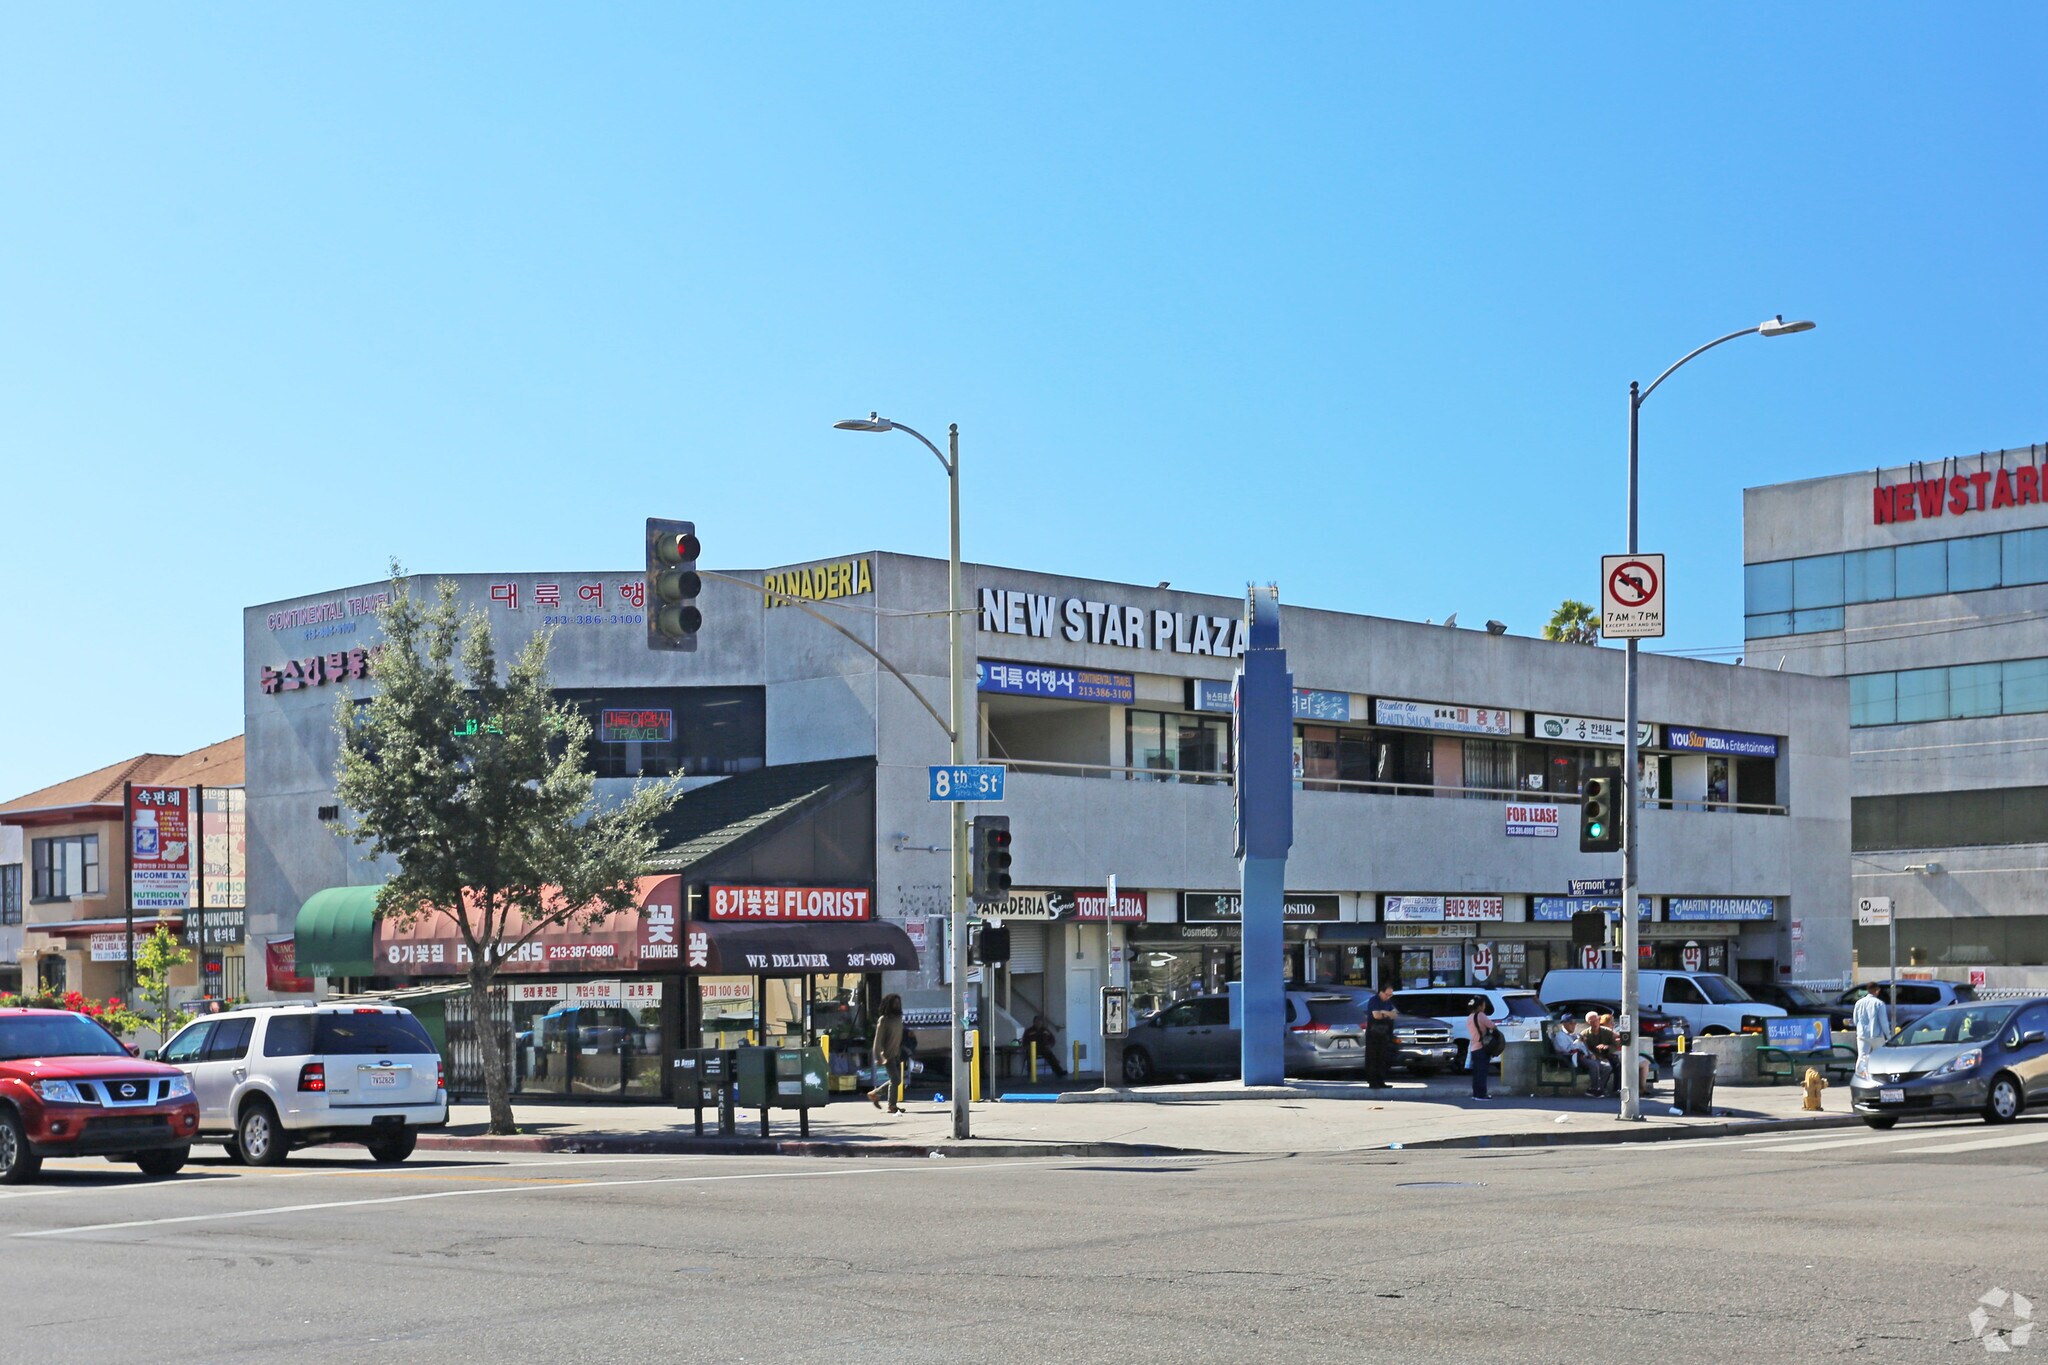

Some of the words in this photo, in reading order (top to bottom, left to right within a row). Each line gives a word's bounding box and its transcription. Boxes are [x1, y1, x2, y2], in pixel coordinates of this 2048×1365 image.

[1873, 463, 2048, 525] NEWSTAR
[765, 559, 873, 609] PANADERIA
[267, 602, 343, 632] CONTINENTAL
[983, 588, 1056, 638] NEW
[1065, 598, 1145, 648] STAR
[1154, 610, 1245, 658] PLAZA
[1607, 613, 1613, 621] 7
[1616, 613, 1629, 621] AM
[1638, 612, 1644, 620] 7
[1646, 612, 1659, 620] PM
[990, 666, 1023, 690] 대륙
[1025, 669, 1074, 694] 여행사
[1078, 672, 1112, 685] CONTINENTAL
[1114, 676, 1131, 687] TRAVEL
[1078, 686, 1131, 699] 213-386-3100
[610, 727, 663, 740] TRAVEL
[1546, 723, 1560, 734] YONG
[1591, 724, 1612, 736] 한의원
[1730, 740, 1775, 754] Entertainment
[979, 774, 997, 792] St
[137, 790, 180, 806] 속편해
[1507, 807, 1526, 822] FOR
[1529, 808, 1557, 823] LEASE
[1572, 880, 1605, 890] Vermont
[715, 890, 778, 916] 8가꽃집
[785, 891, 866, 917] FLORIST
[1078, 897, 1143, 916] TORTILERIA
[1284, 903, 1315, 914] osmo
[1682, 900, 1708, 911] MARTIN
[1710, 900, 1762, 914] PHARMACY
[187, 912, 244, 927] ACPUNCTURE
[647, 905, 674, 943] 꽃
[214, 928, 236, 942] 한의원
[1182, 927, 1218, 937] Cosmetics
[1387, 925, 1421, 937] MAILBOX
[388, 944, 444, 964] 8가꽃집
[550, 945, 614, 958] 213-387-0980
[641, 944, 678, 959] FLOWERS
[689, 933, 708, 967] 꽃
[746, 955, 767, 967] WE
[773, 955, 829, 967] DELIVER
[848, 953, 895, 966] 387-0980
[576, 986, 595, 998] 개업식
[598, 986, 610, 998] 화분
[701, 985, 716, 997] 장미
[719, 985, 731, 996] 100
[734, 985, 750, 997] 송이
[590, 1000, 605, 1009] PARA
[606, 1000, 624, 1009] PARTY
[633, 999, 660, 1008] FUNERAL
